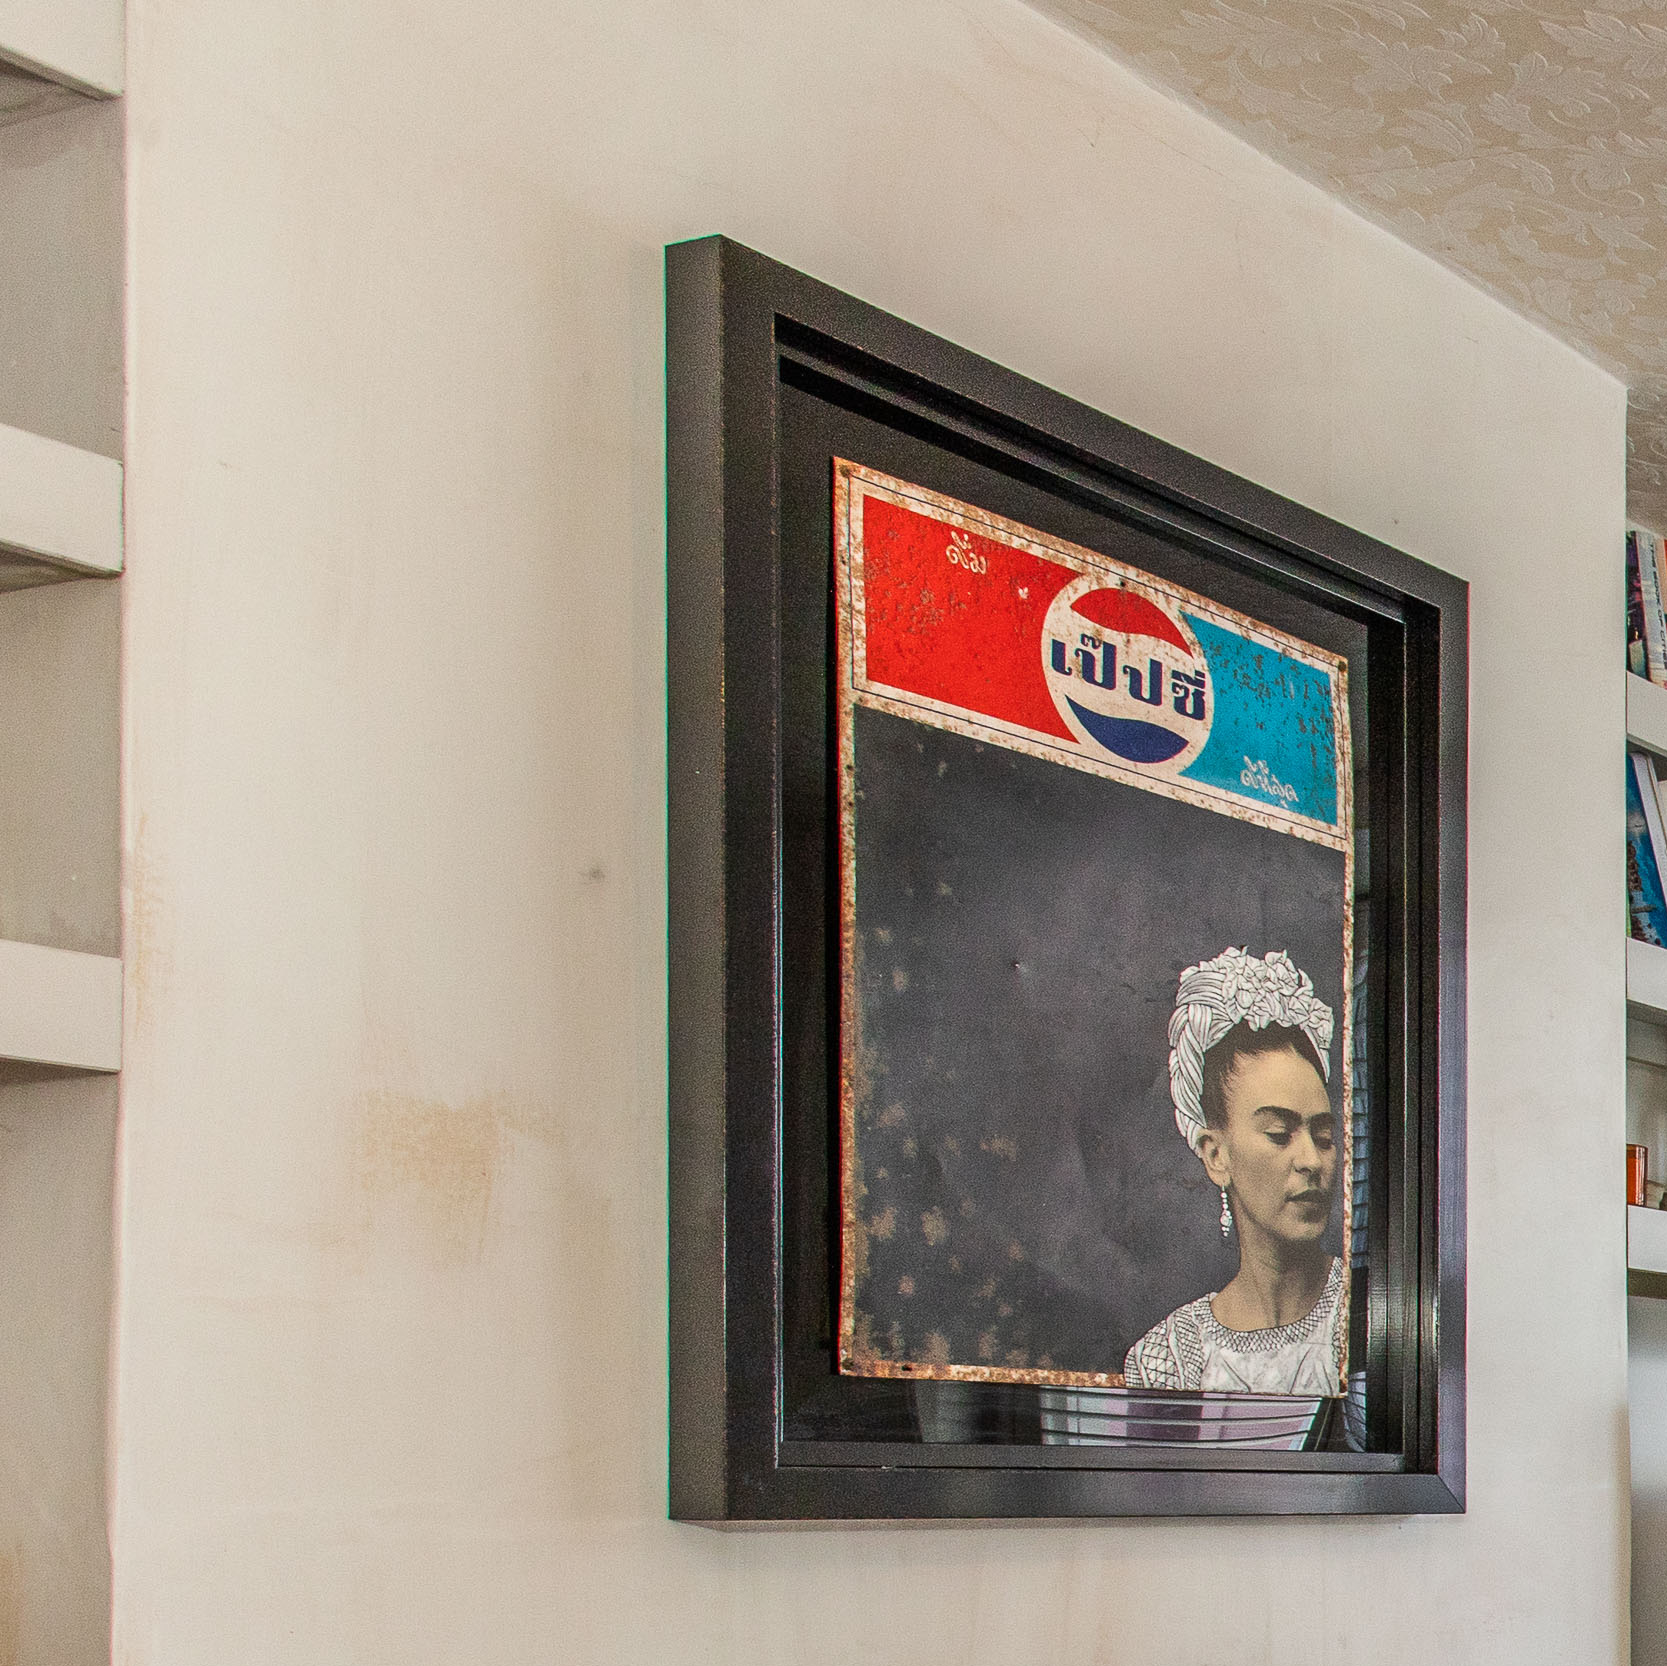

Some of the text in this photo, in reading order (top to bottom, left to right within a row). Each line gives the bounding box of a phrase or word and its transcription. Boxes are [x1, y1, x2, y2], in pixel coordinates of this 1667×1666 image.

[1652, 569, 1661, 605] BOOK
[1656, 608, 1664, 626] OF
[1050, 633, 1207, 721] เป๊ปซี่
